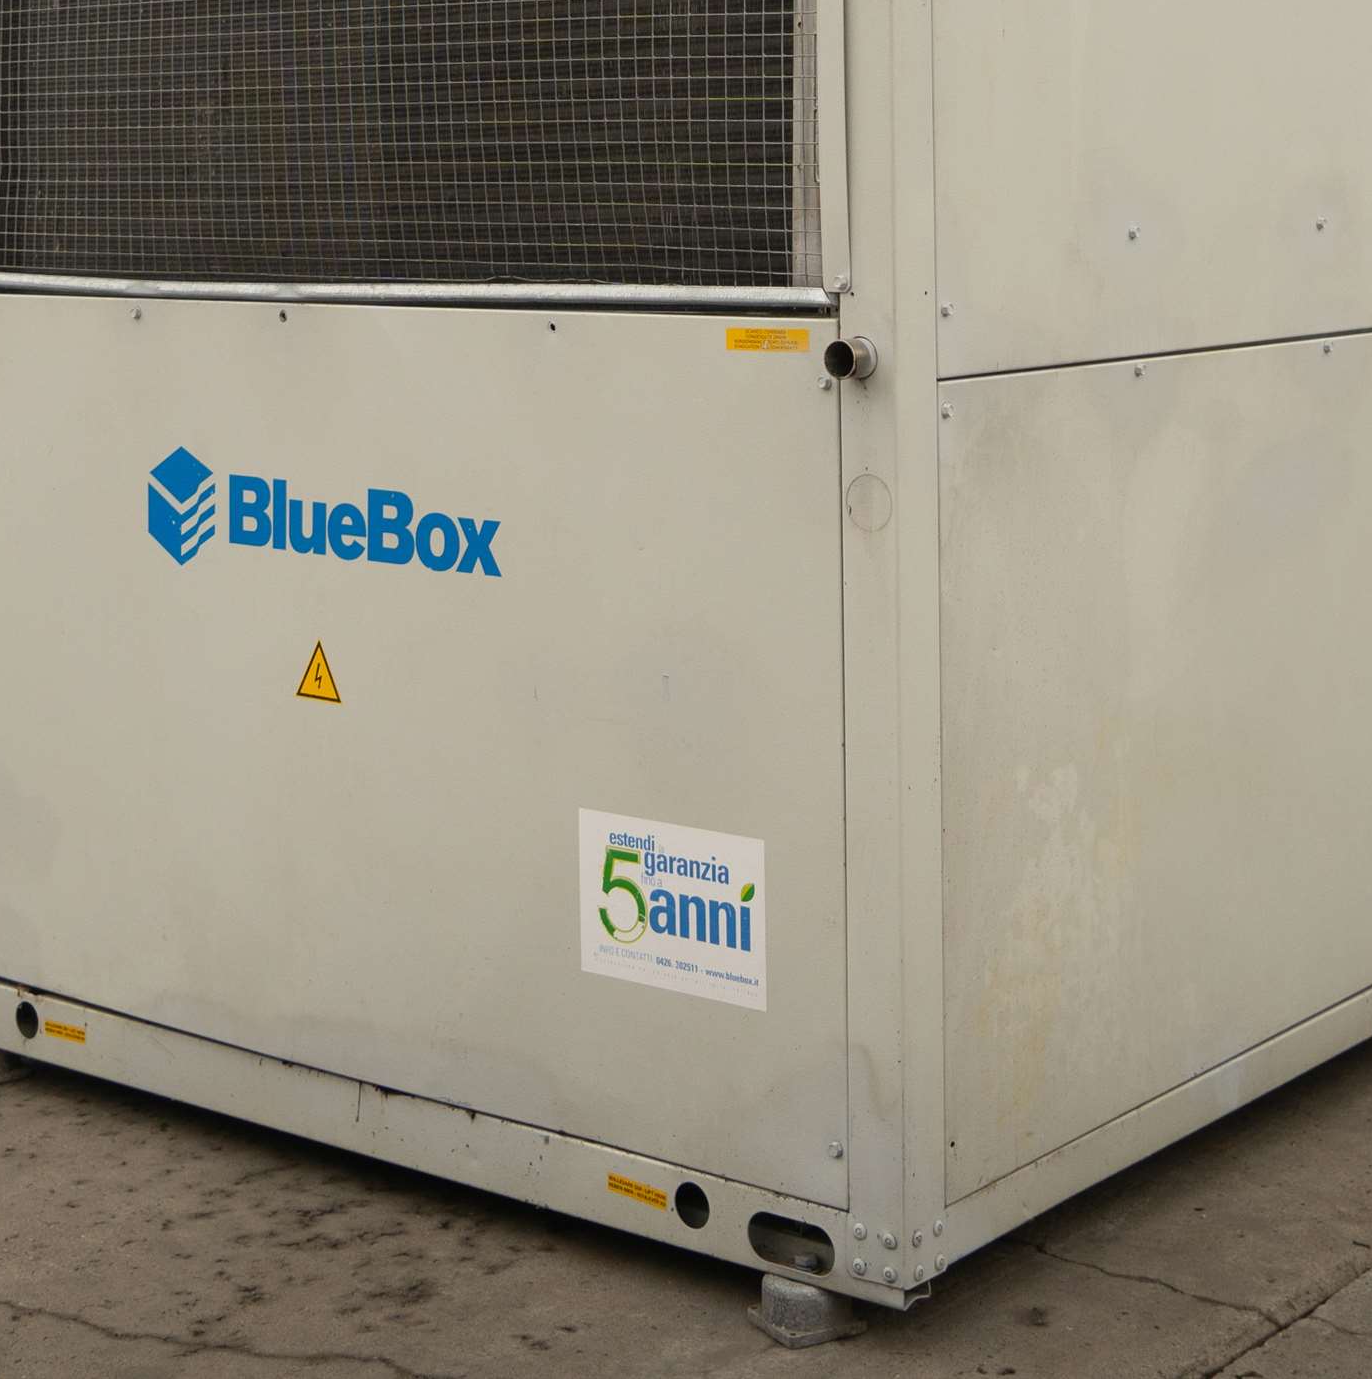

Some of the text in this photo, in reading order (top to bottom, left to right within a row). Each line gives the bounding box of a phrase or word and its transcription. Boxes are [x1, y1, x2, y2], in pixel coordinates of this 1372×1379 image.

[229, 474, 502, 577] BlueBox
[608, 832, 655, 852] estendi
[644, 851, 729, 885] garanzia
[597, 845, 755, 952] 5 anni
